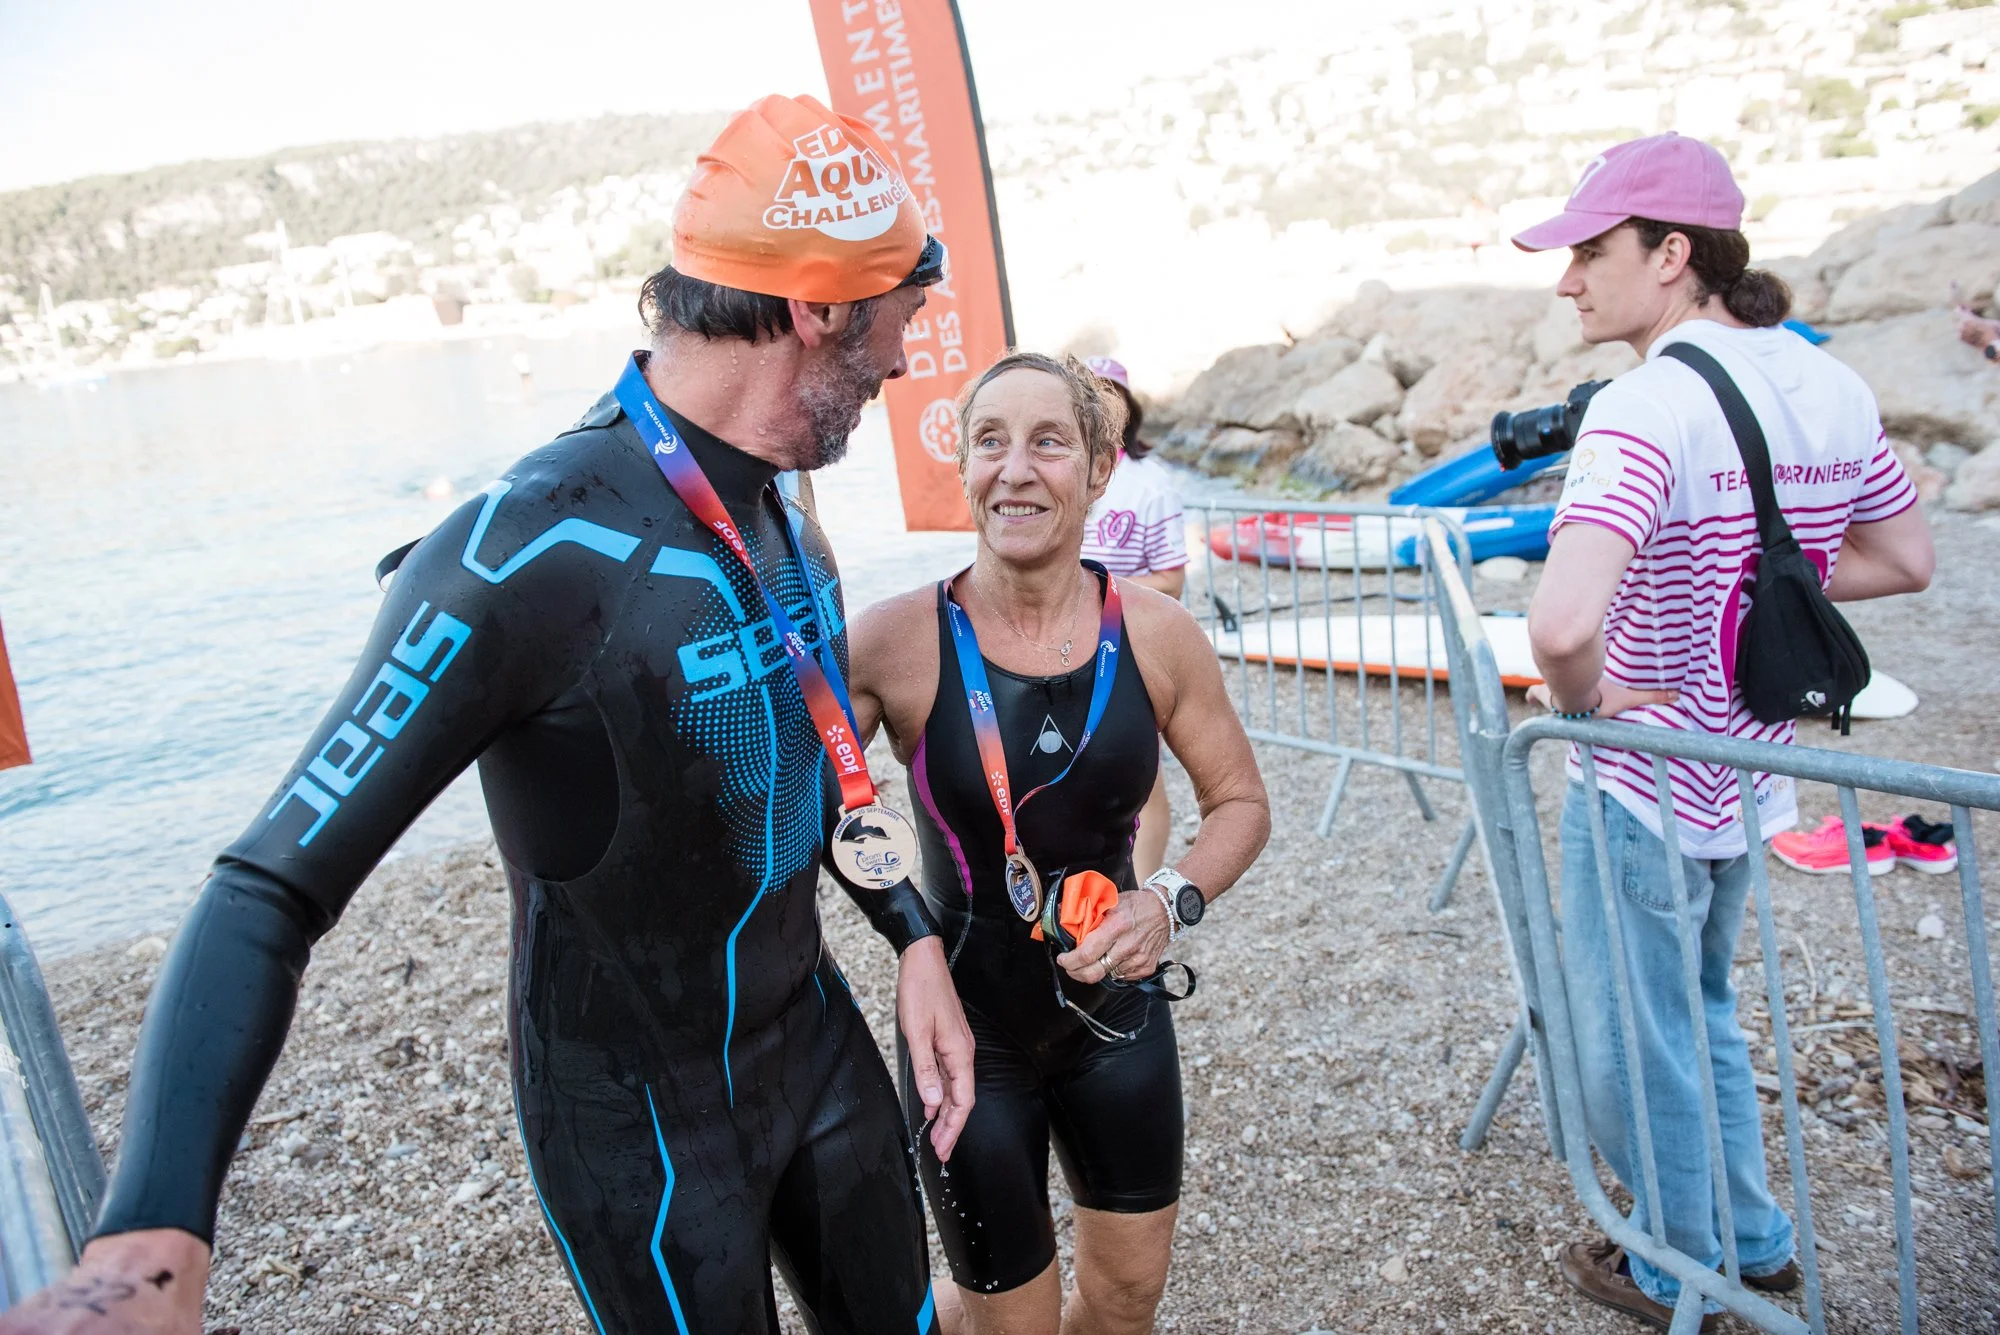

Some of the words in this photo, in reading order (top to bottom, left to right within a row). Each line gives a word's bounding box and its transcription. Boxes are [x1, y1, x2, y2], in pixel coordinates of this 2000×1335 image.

[765, 177, 908, 227] CHALLENGE
[936, 310, 968, 373] DES
[643, 401, 671, 441] FFNATATION
[1710, 470, 1750, 492] TEA
[786, 631, 806, 657] AQUA
[974, 689, 990, 713] AQUA
[834, 814, 854, 840] FINISHER
[866, 808, 900, 822] SEPTEMBRE
